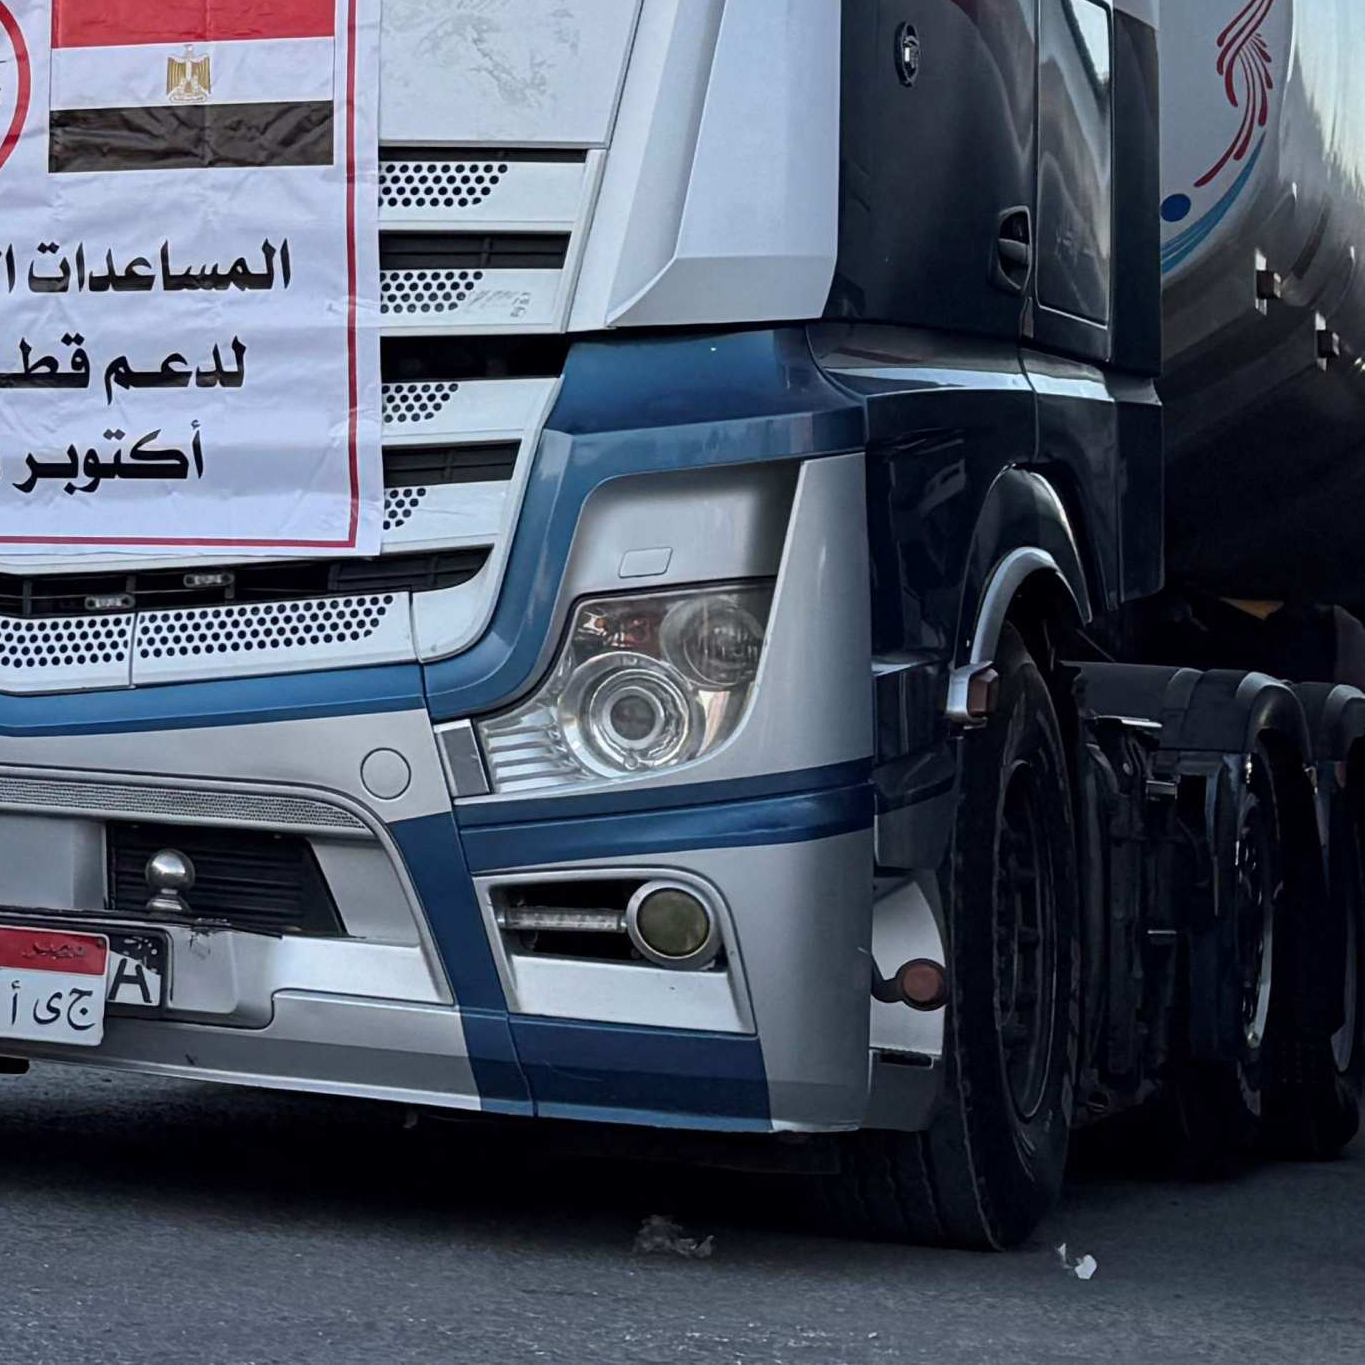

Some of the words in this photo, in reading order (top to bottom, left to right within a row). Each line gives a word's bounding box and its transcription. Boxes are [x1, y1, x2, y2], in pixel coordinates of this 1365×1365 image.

[29, 238, 292, 296] المساعدات
[104, 335, 247, 406] لدعم
[14, 420, 206, 495] أكتوبر
[22, 941, 87, 960] مصر
